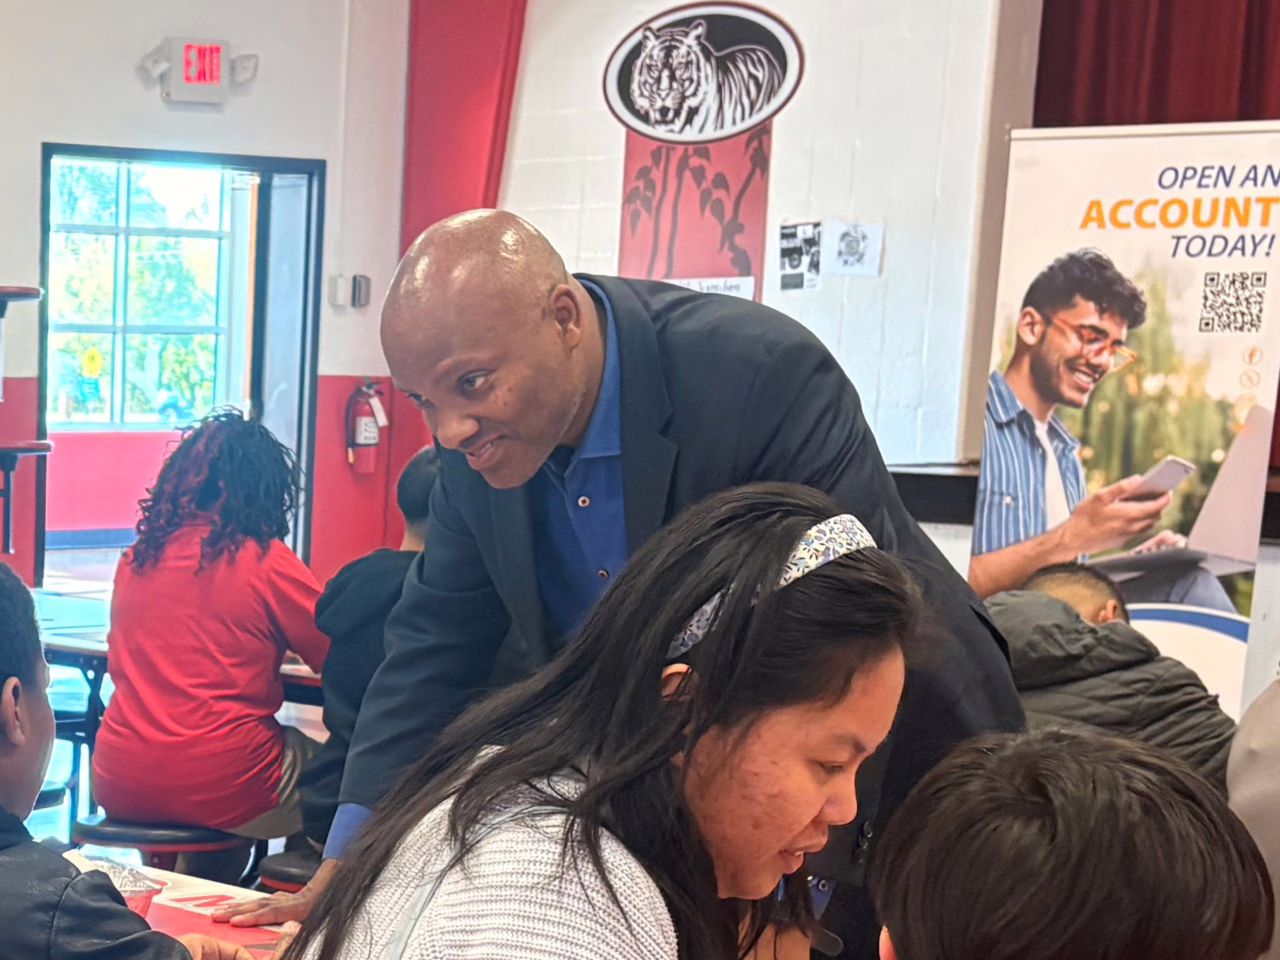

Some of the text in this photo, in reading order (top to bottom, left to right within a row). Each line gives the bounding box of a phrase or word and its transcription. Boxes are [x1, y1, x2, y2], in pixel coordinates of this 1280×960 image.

[183, 44, 222, 86] EXIT
[1157, 164, 1280, 190] OPEN AN
[1079, 195, 1280, 230] ACCOUNT
[1171, 234, 1276, 258] TODAY!
